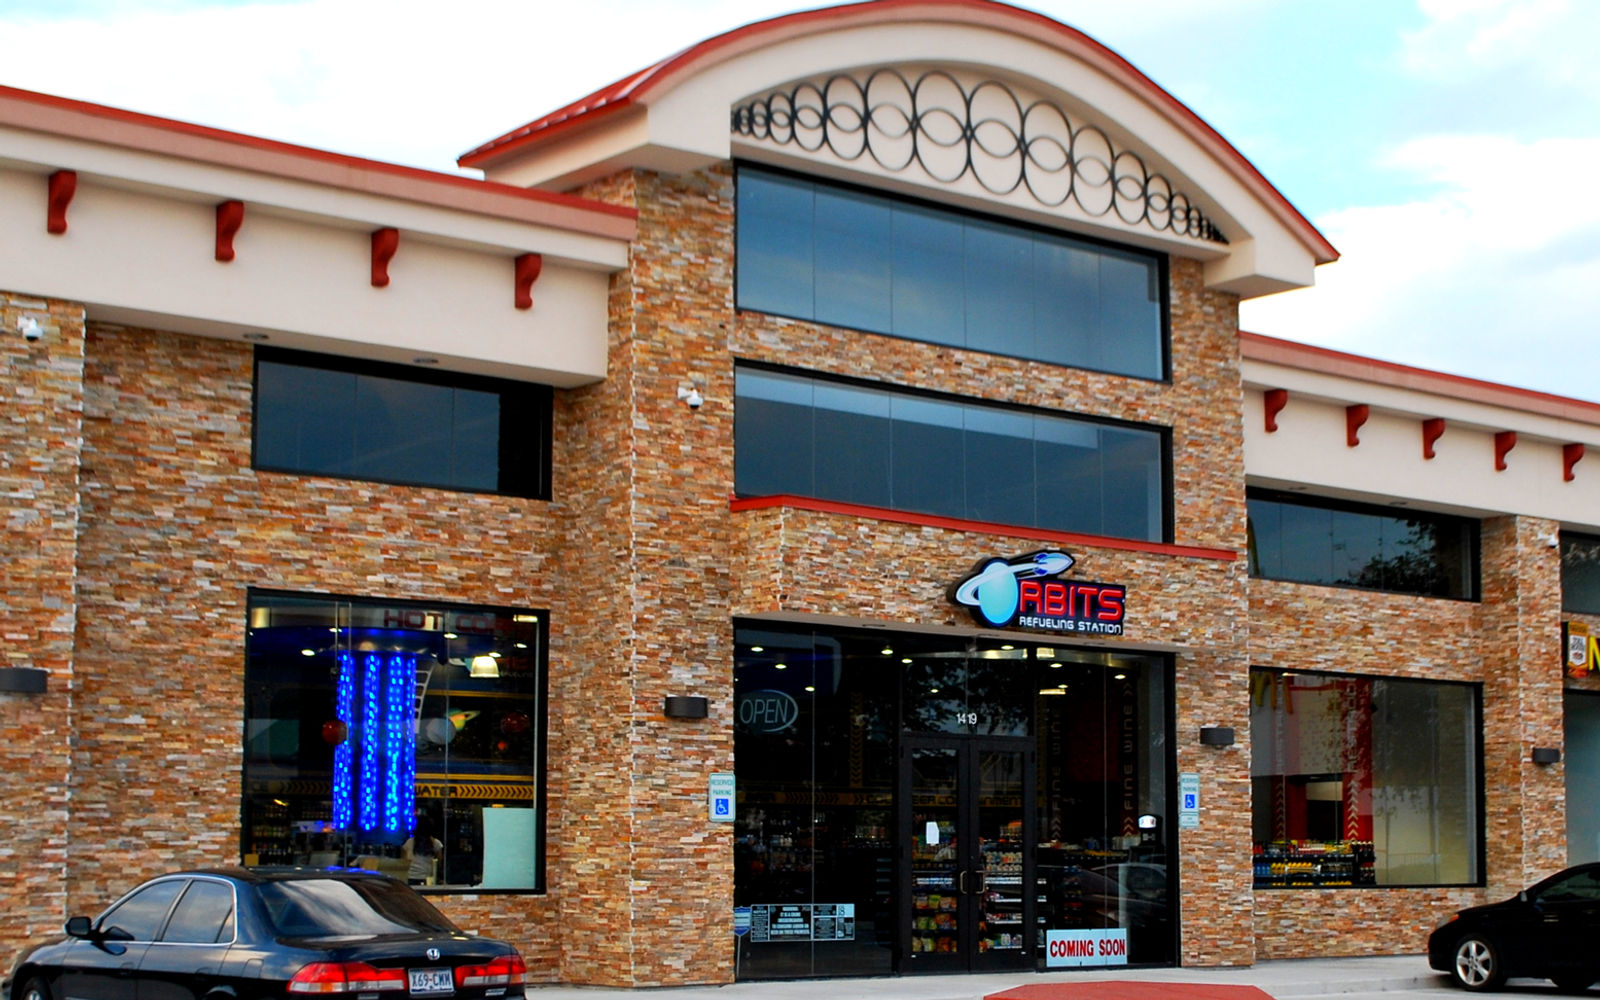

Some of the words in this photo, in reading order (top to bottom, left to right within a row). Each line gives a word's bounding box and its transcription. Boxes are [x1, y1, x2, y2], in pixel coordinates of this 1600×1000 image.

[384, 610, 444, 630] HOT
[1019, 616, 1074, 630] REFUELING
[1078, 621, 1121, 634] STATION
[739, 698, 789, 724] OPEN
[956, 712, 978, 725] 1419
[1050, 940, 1094, 957] COMING
[1099, 938, 1126, 956] SOON
